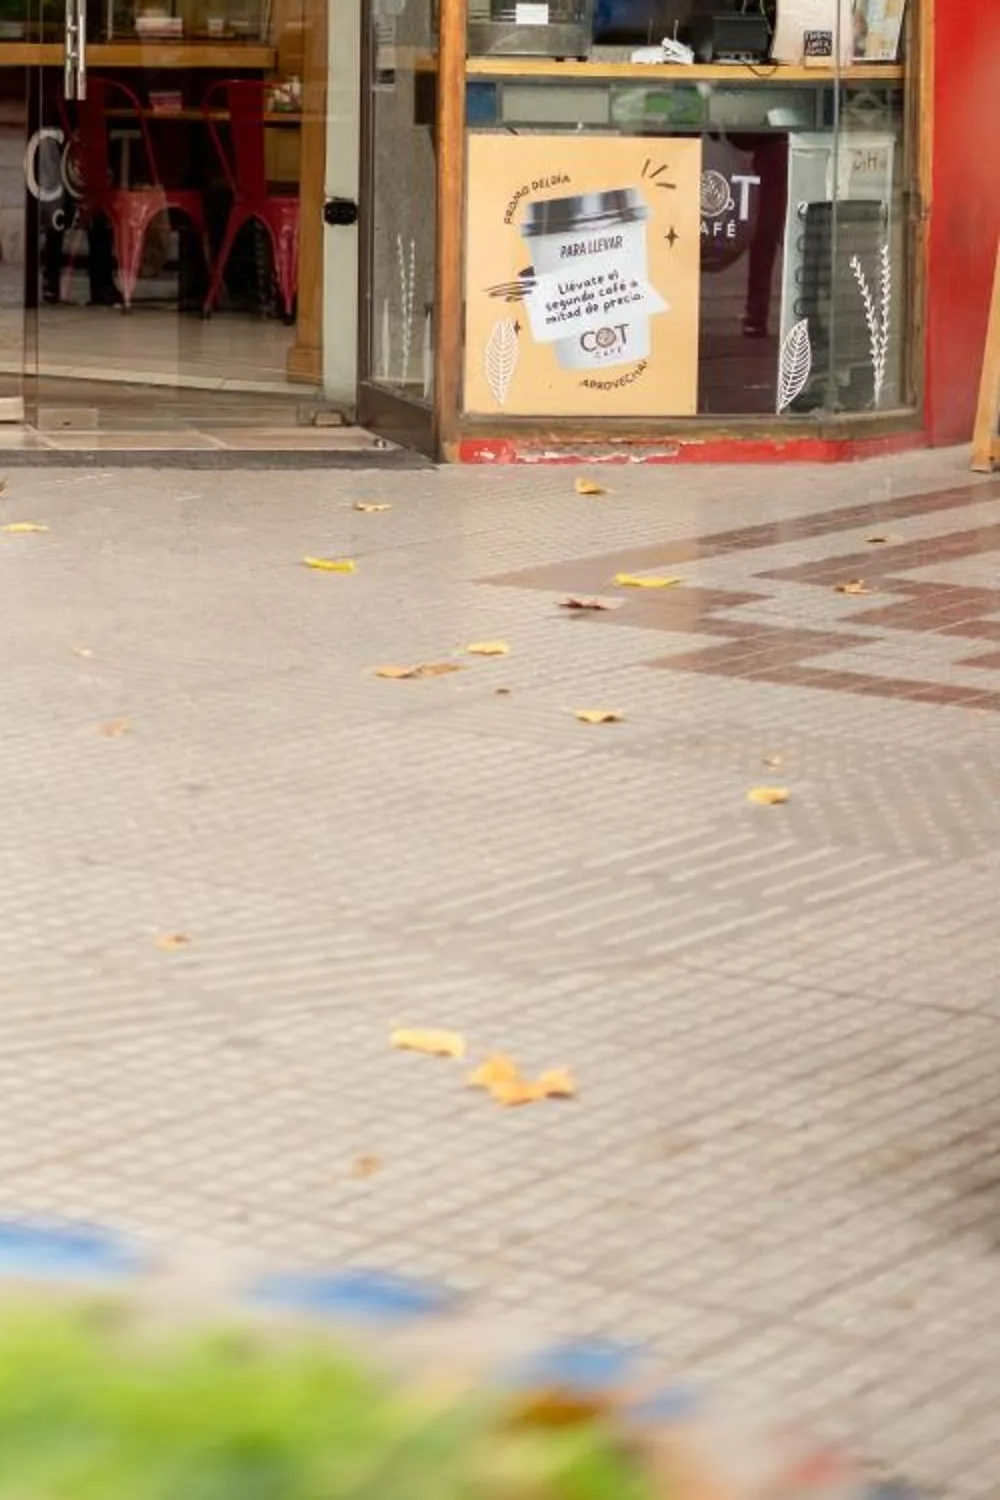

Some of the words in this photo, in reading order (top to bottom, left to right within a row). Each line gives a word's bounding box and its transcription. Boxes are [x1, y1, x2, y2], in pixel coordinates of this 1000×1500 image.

[560, 243, 586, 259] PARA
[588, 235, 623, 254] LLEVAR
[545, 290, 595, 312] segundo
[599, 280, 627, 297] café
[545, 306, 581, 325] mitad
[585, 302, 599, 314] de
